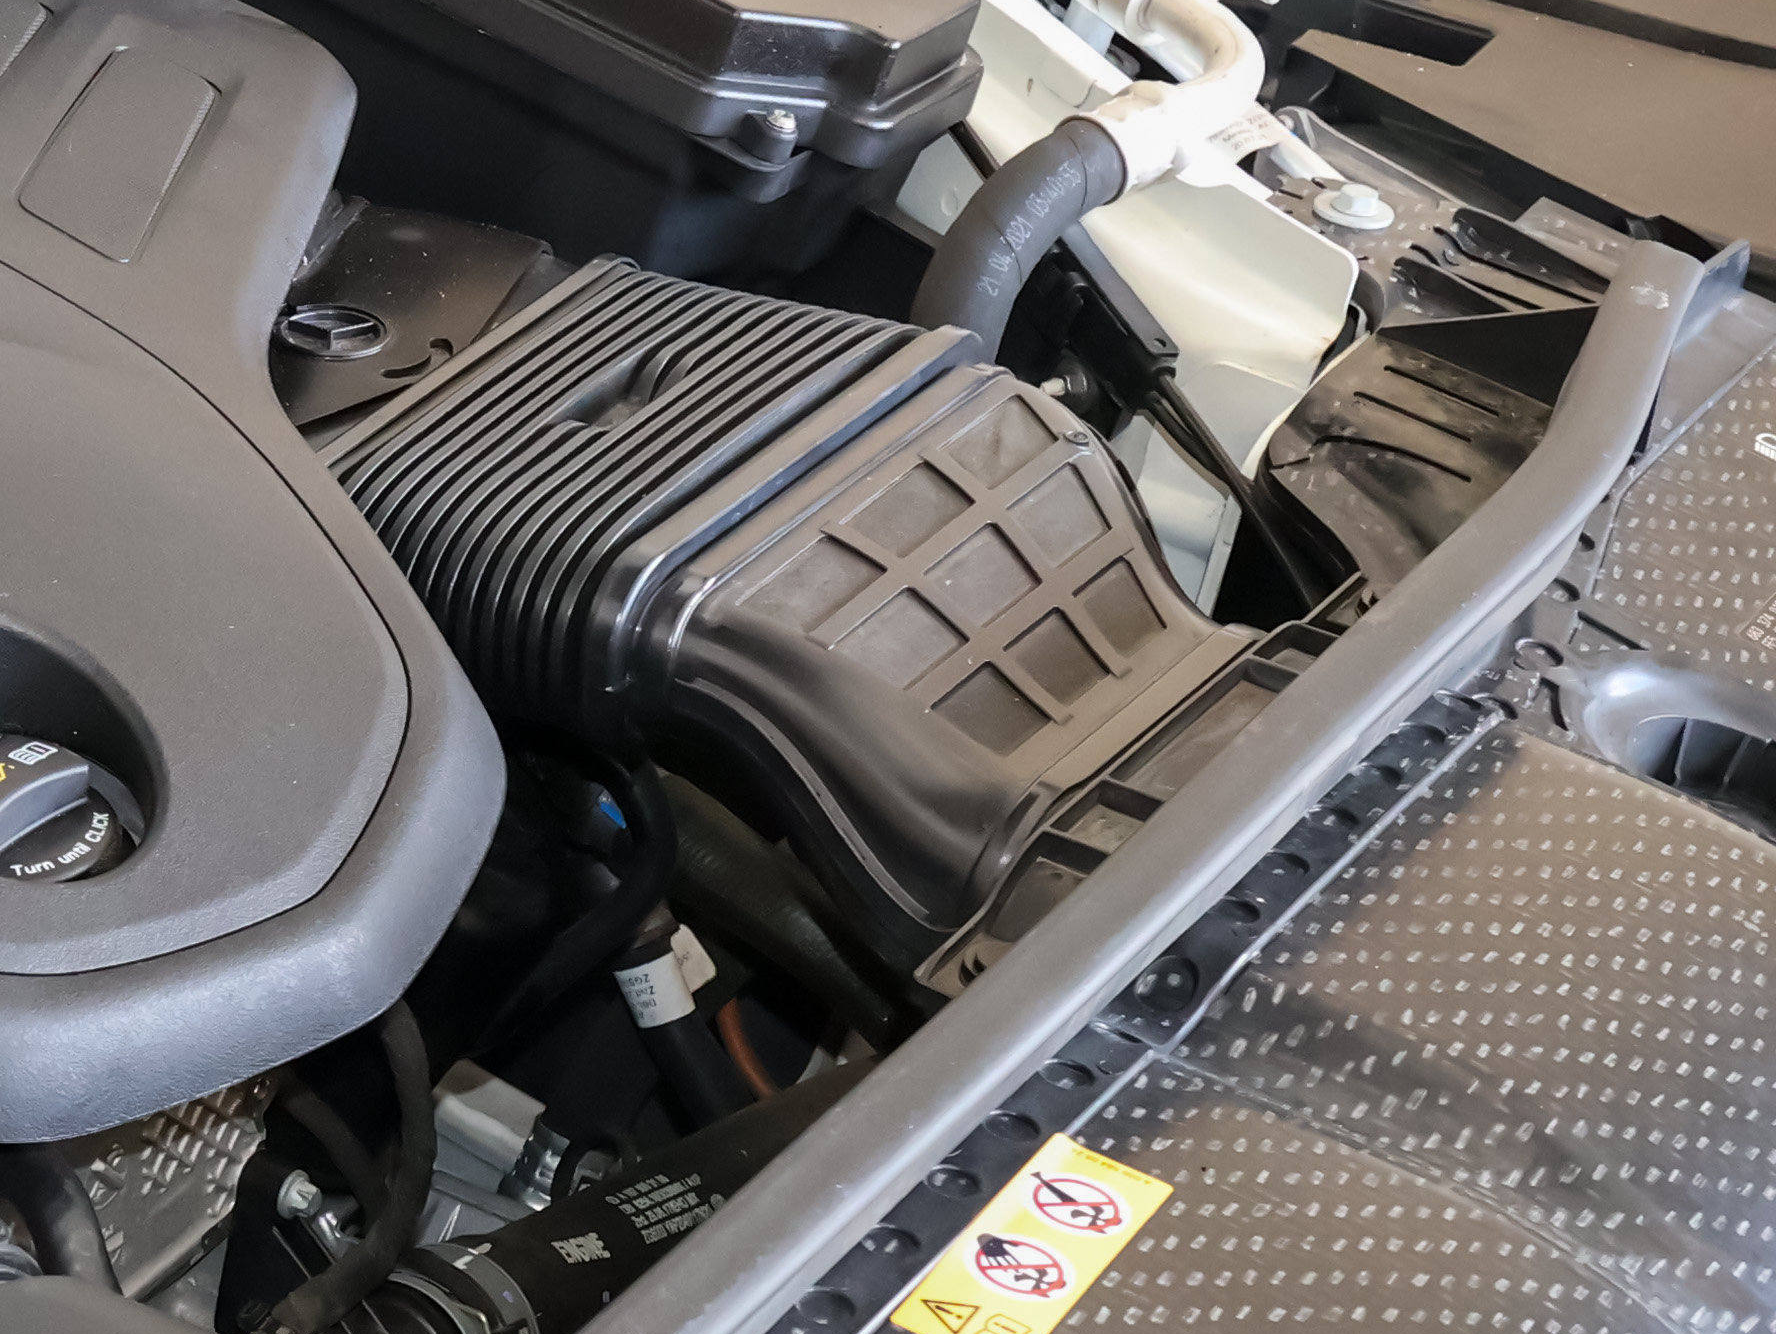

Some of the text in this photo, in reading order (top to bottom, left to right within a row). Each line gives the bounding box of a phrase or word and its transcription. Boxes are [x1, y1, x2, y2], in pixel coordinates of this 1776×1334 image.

[10, 812, 110, 877] Turn until CLICK
[550, 1232, 611, 1264] ENGINE
